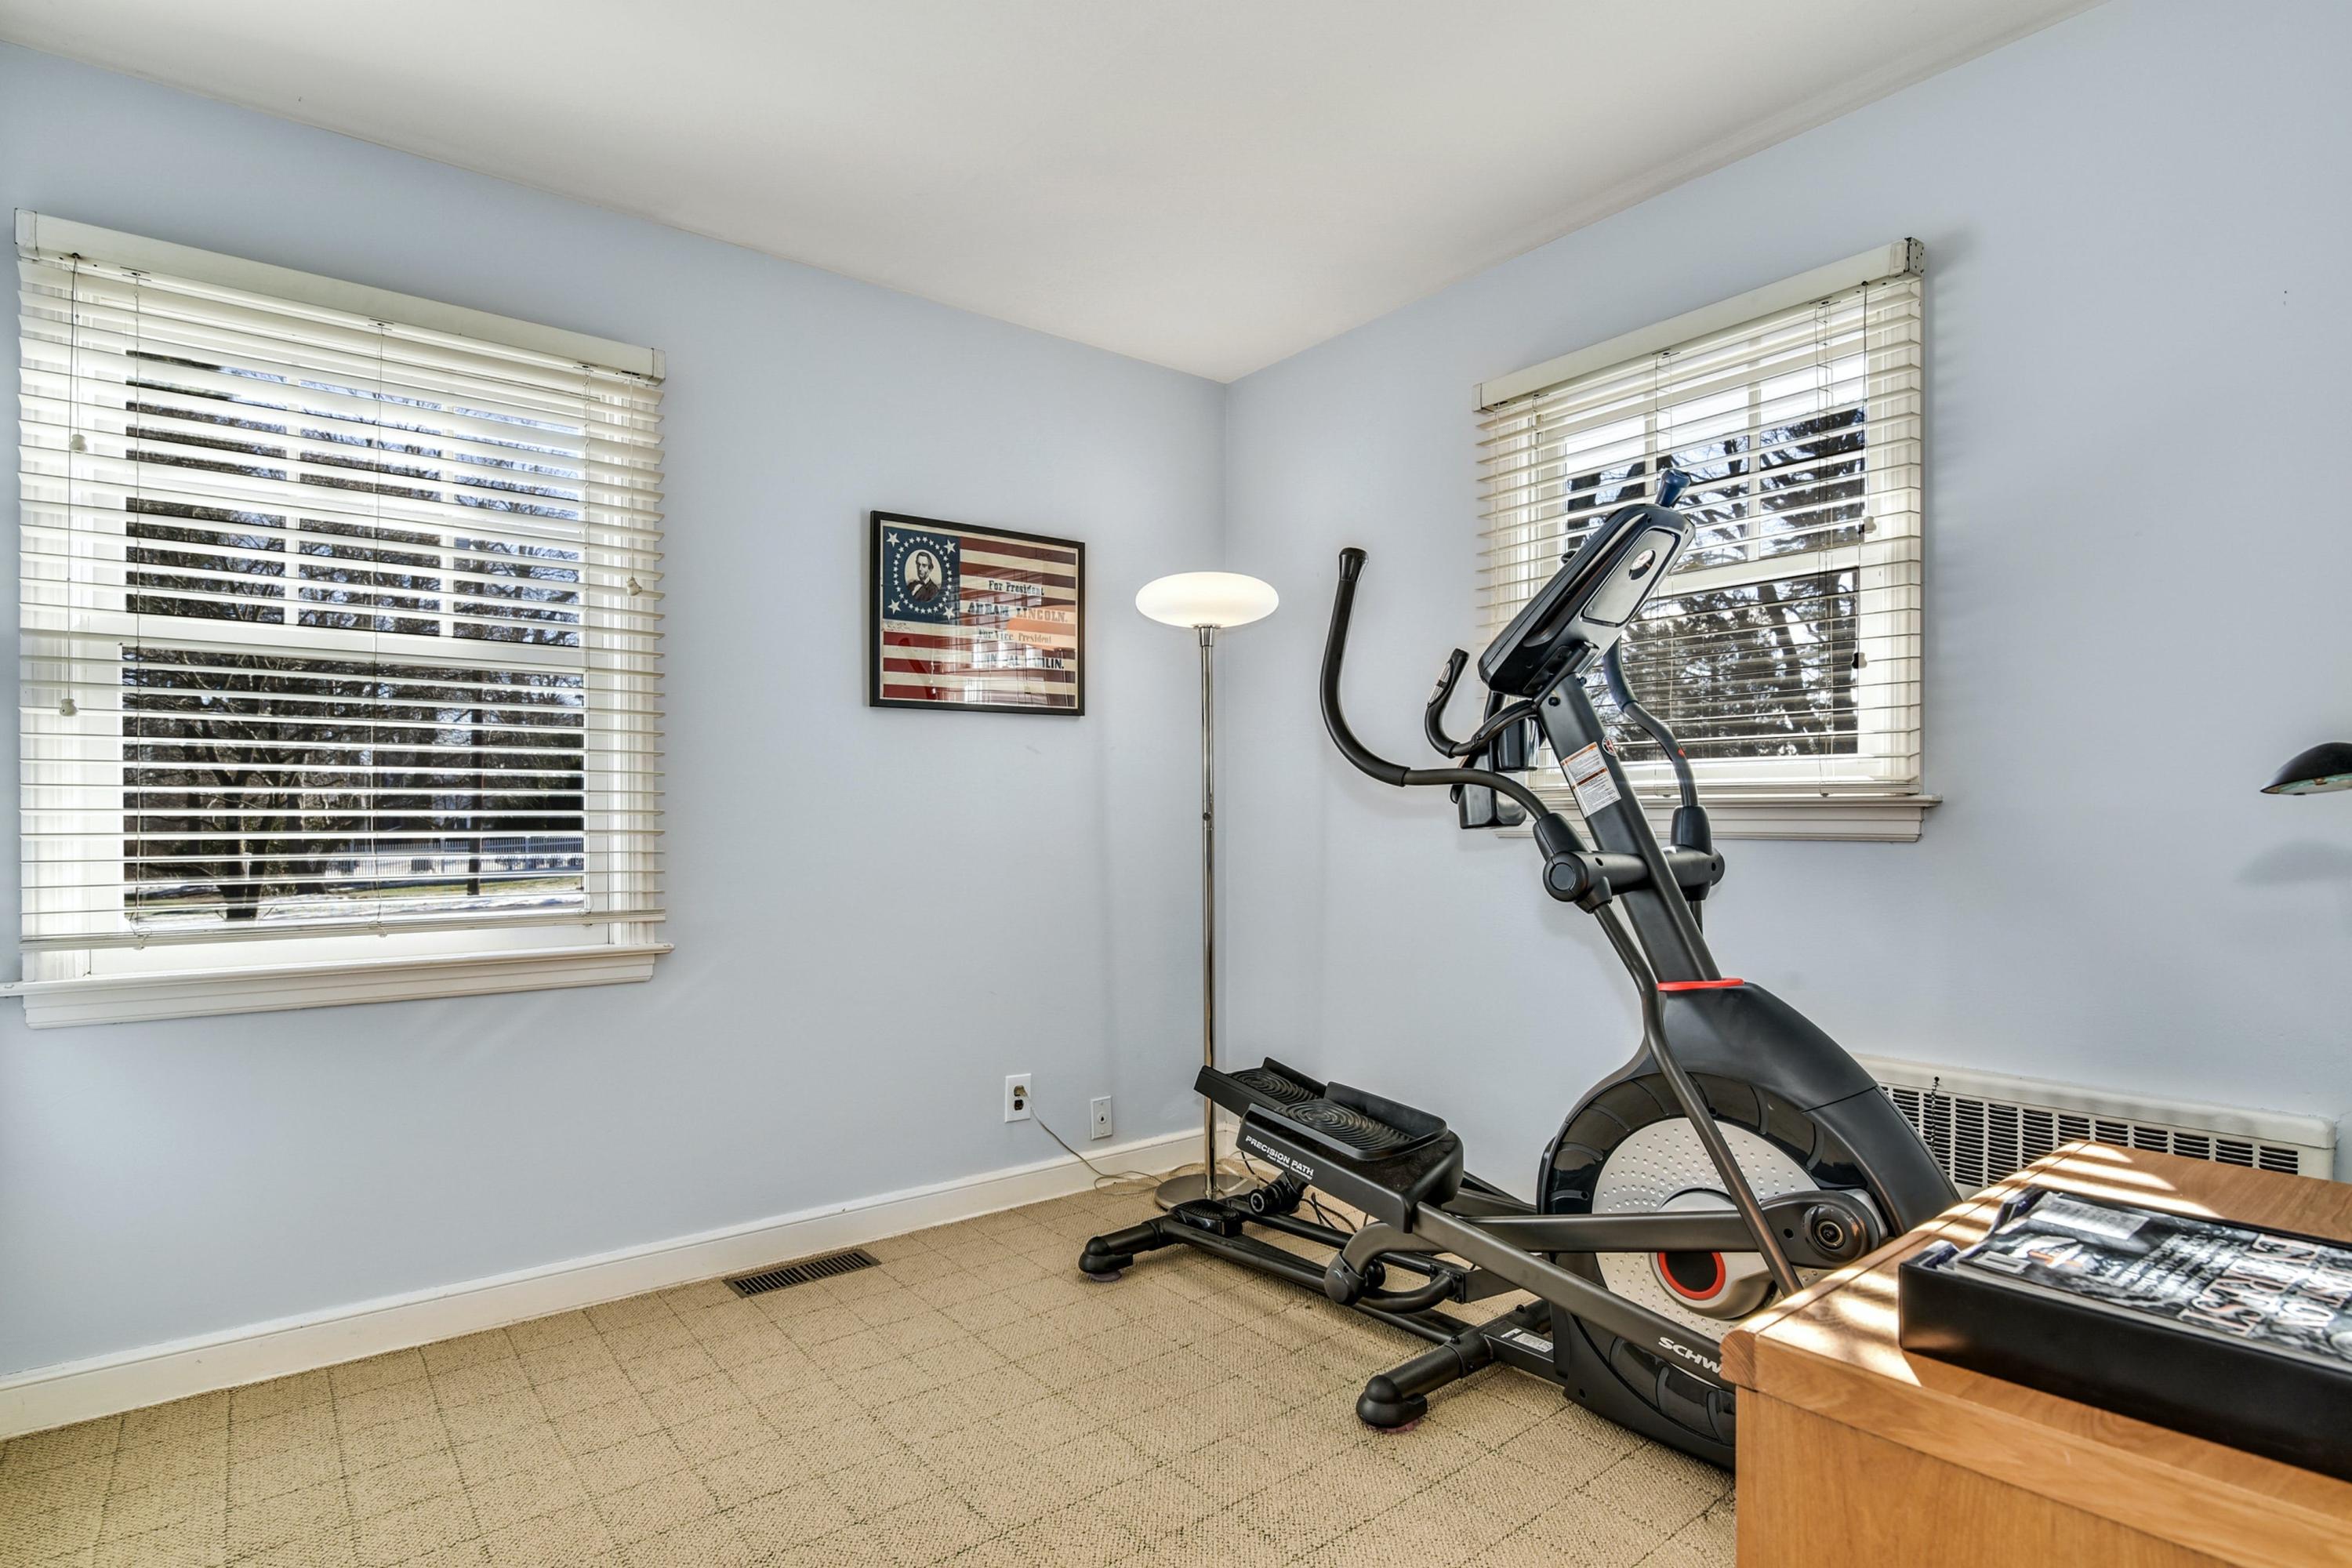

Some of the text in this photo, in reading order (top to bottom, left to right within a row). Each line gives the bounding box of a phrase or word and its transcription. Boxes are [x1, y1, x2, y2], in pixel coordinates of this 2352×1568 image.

[988, 580, 1044, 596] For President
[967, 601, 1069, 622] ABRAM LINCOLN.
[995, 630, 1014, 641] Vice
[1018, 632, 1052, 644] President
[1245, 1134, 1315, 1177] PRECISION PATH
[2179, 1232, 2321, 1336] EVEREST
